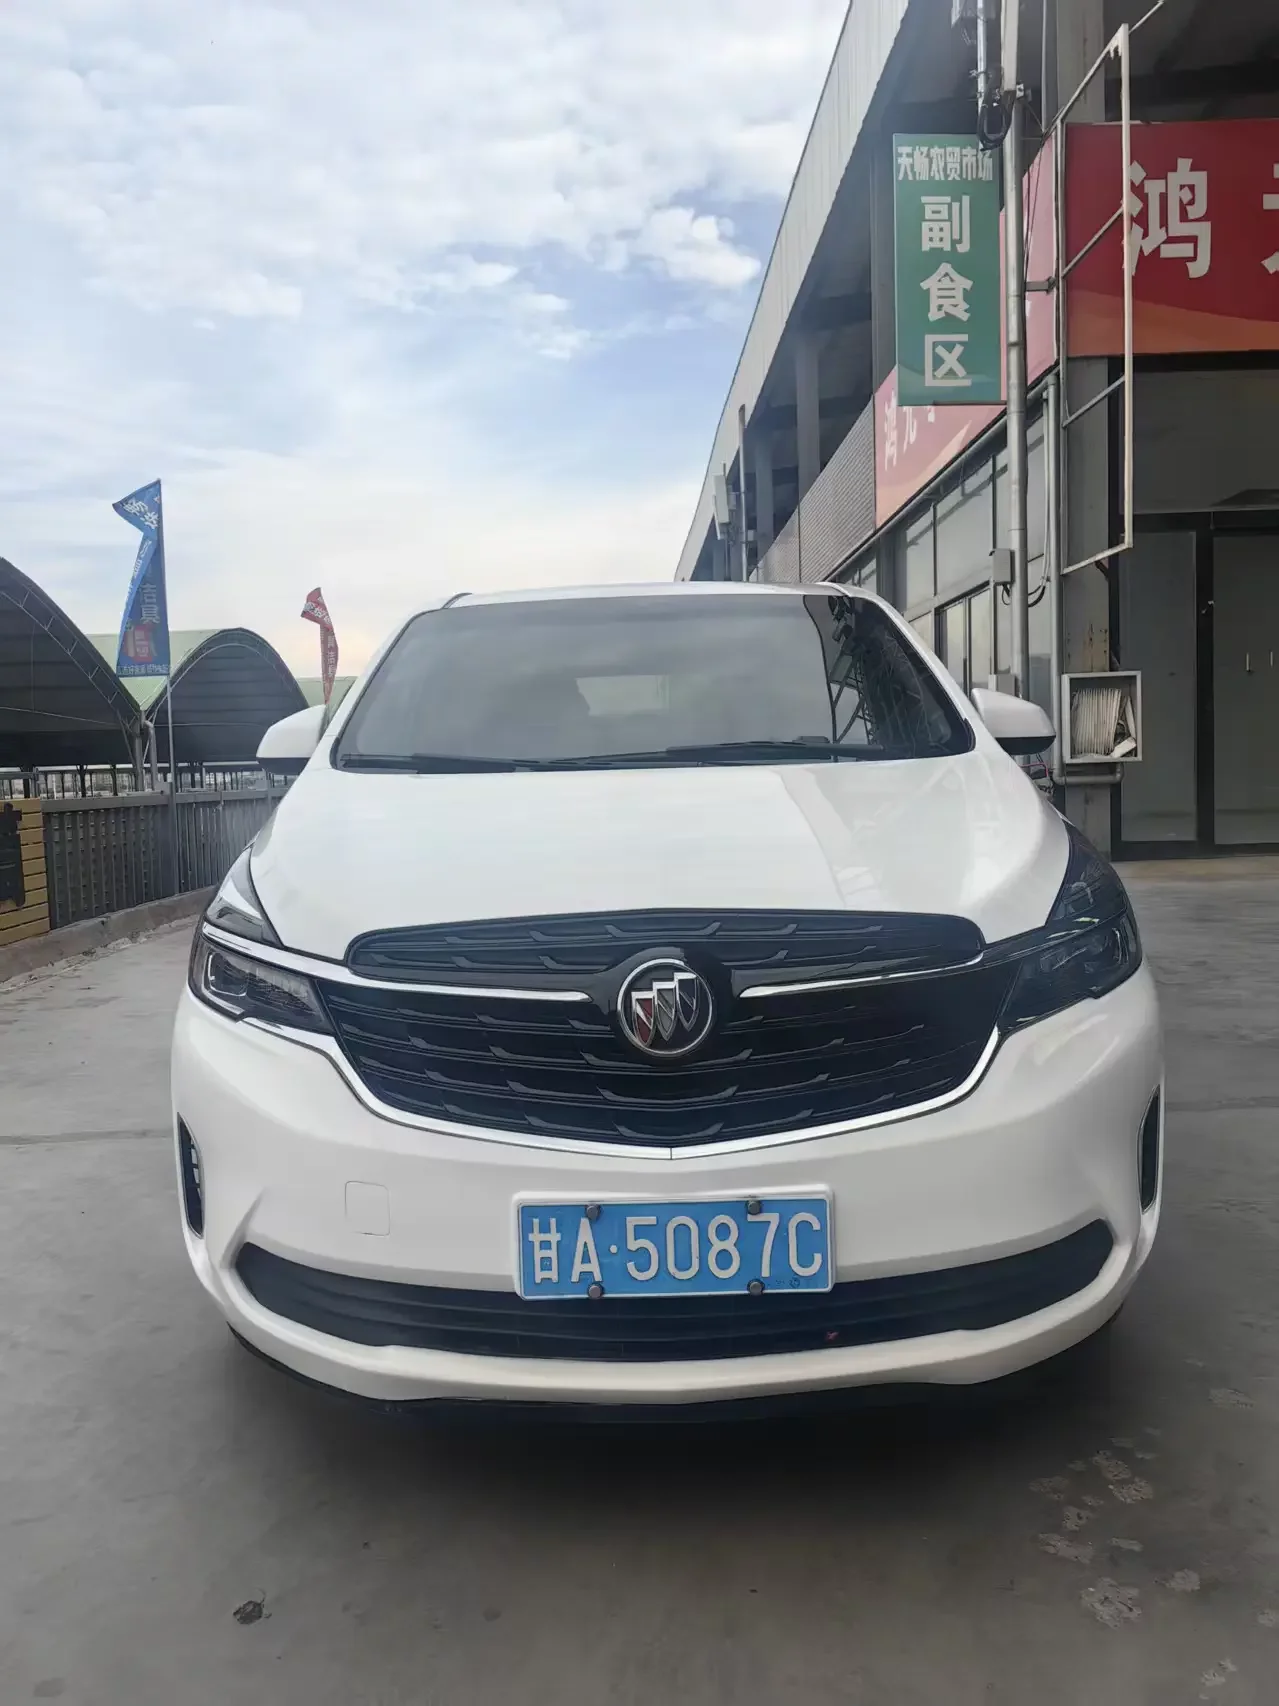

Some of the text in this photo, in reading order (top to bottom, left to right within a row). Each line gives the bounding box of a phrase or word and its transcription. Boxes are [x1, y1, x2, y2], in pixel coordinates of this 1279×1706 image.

[1122, 157, 1279, 279] 鸿
[920, 195, 973, 387] 副食区
[528, 1212, 823, 1284] 甘A·5087C
